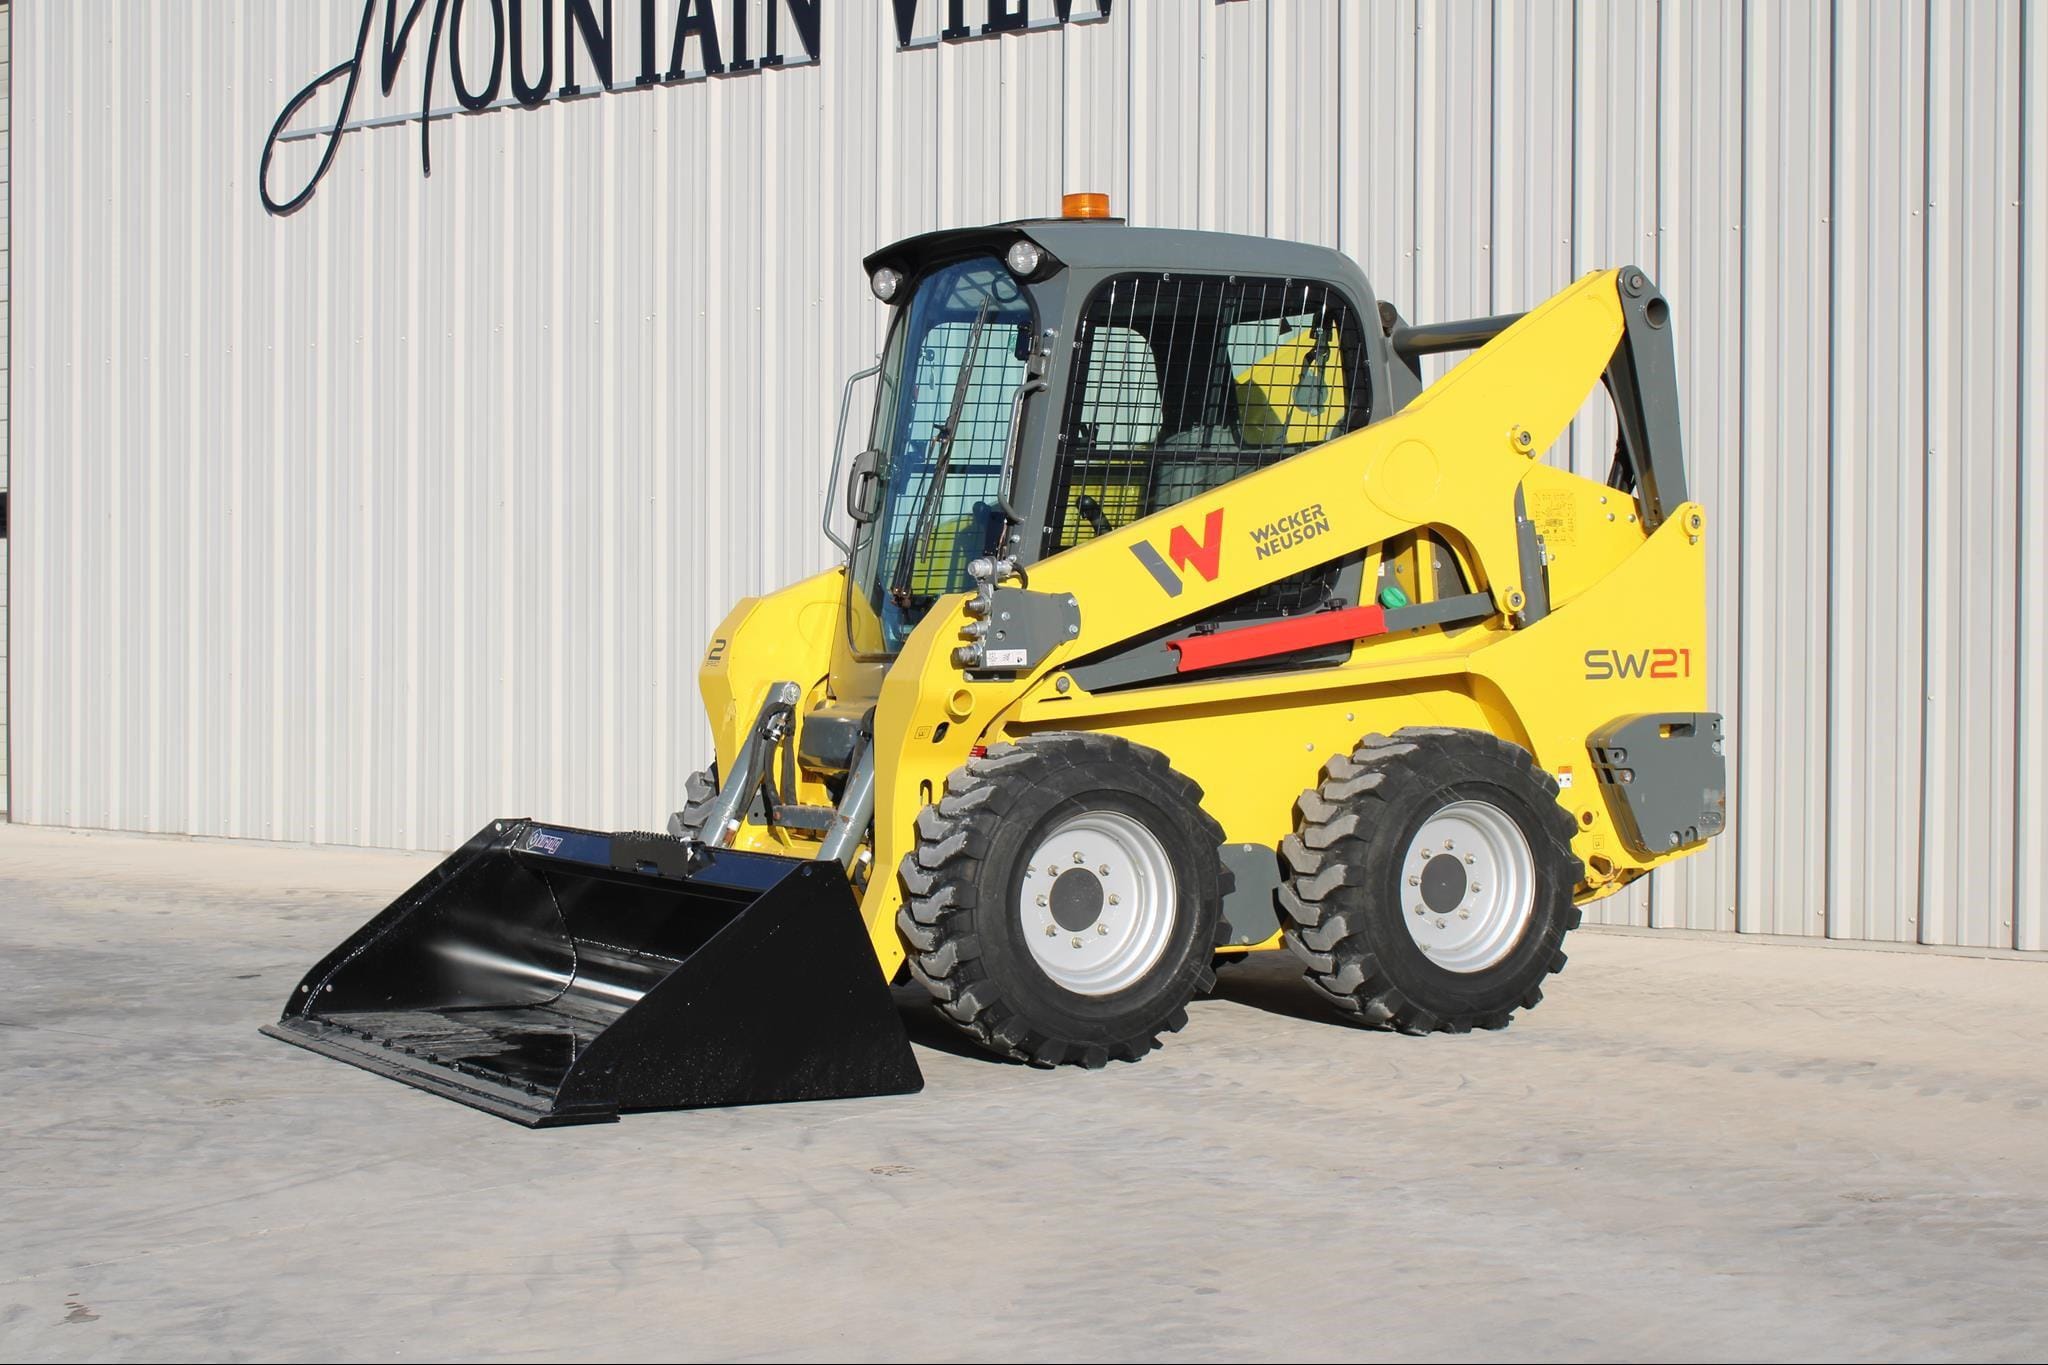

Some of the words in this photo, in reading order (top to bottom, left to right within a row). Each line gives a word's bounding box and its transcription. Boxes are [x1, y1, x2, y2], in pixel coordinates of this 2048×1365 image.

[1250, 504, 1325, 543] WACKER
[1256, 518, 1330, 560] NEUSON
[1584, 648, 1690, 680] SW21
